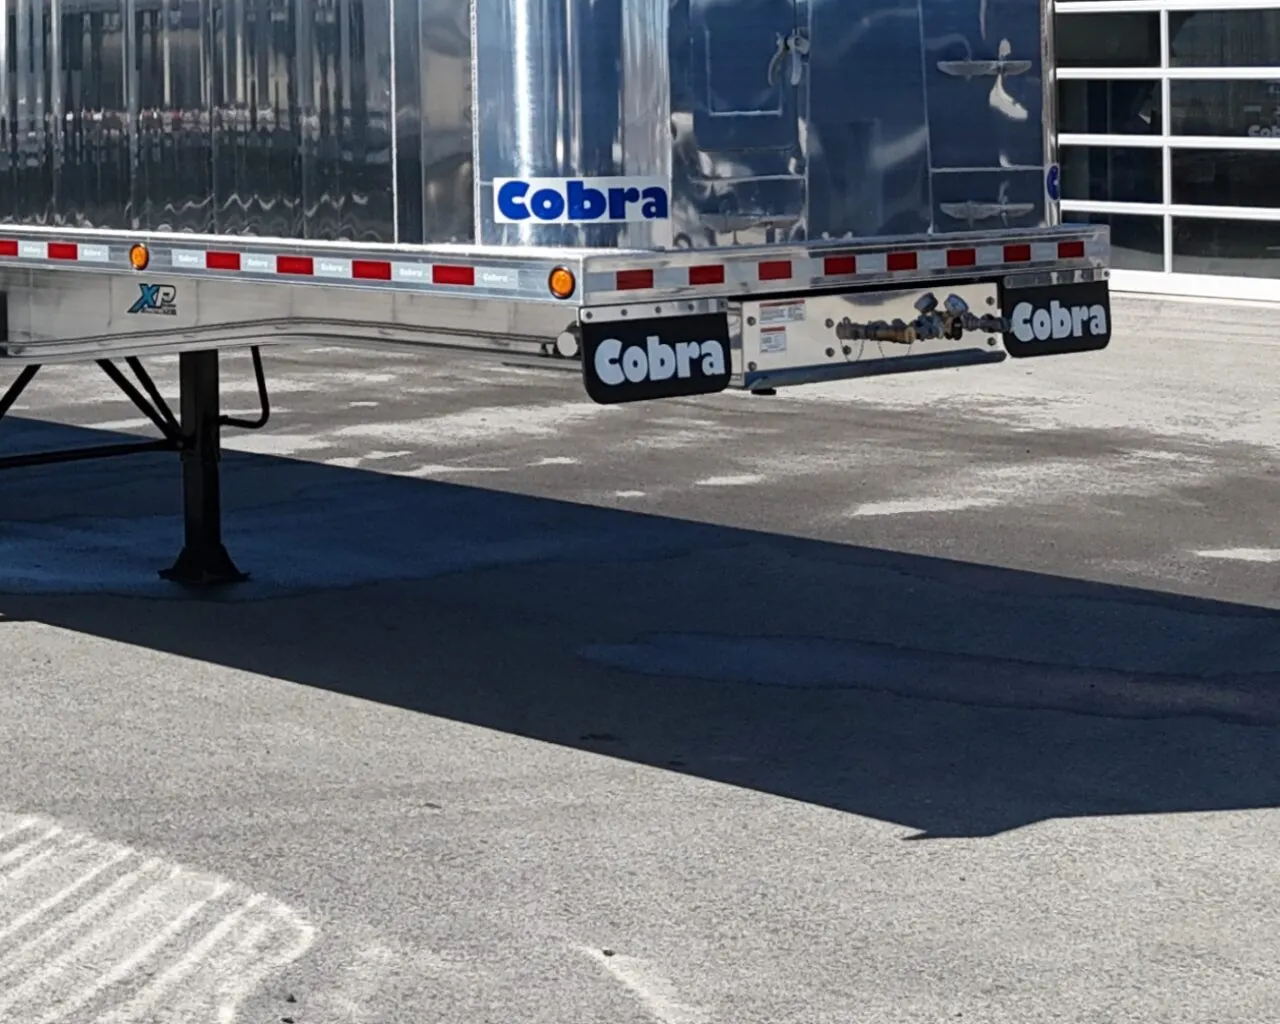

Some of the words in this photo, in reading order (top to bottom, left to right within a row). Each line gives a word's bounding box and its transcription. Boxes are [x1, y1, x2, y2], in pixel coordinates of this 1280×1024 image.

[497, 180, 668, 221] Cobra
[126, 283, 177, 314] XP
[1011, 300, 1107, 342] Cobra
[594, 335, 726, 385] Cobra
